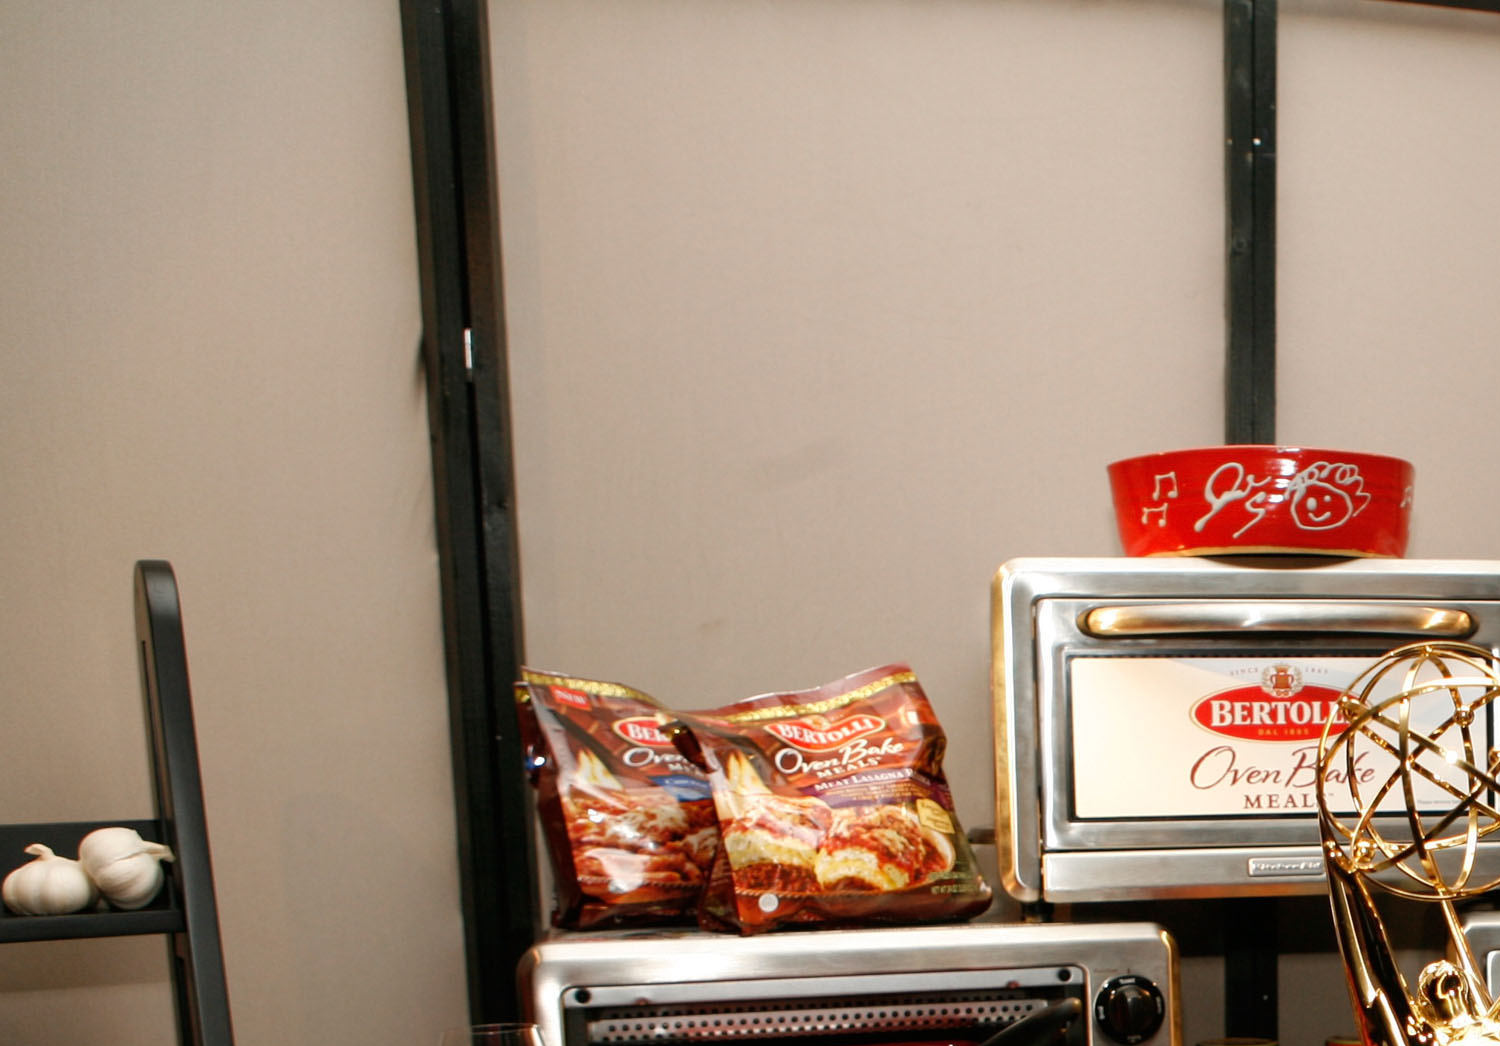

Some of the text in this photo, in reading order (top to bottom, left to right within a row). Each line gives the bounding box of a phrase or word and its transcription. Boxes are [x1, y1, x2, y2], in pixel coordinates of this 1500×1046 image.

[1210, 700, 1351, 727] BERTOLL
[777, 718, 875, 745] BERTOLLI
[775, 737, 904, 774] Oven Bake
[816, 757, 880, 778] MEALS
[1190, 745, 1282, 790] Oven
[1244, 793, 1328, 809] MEAL
